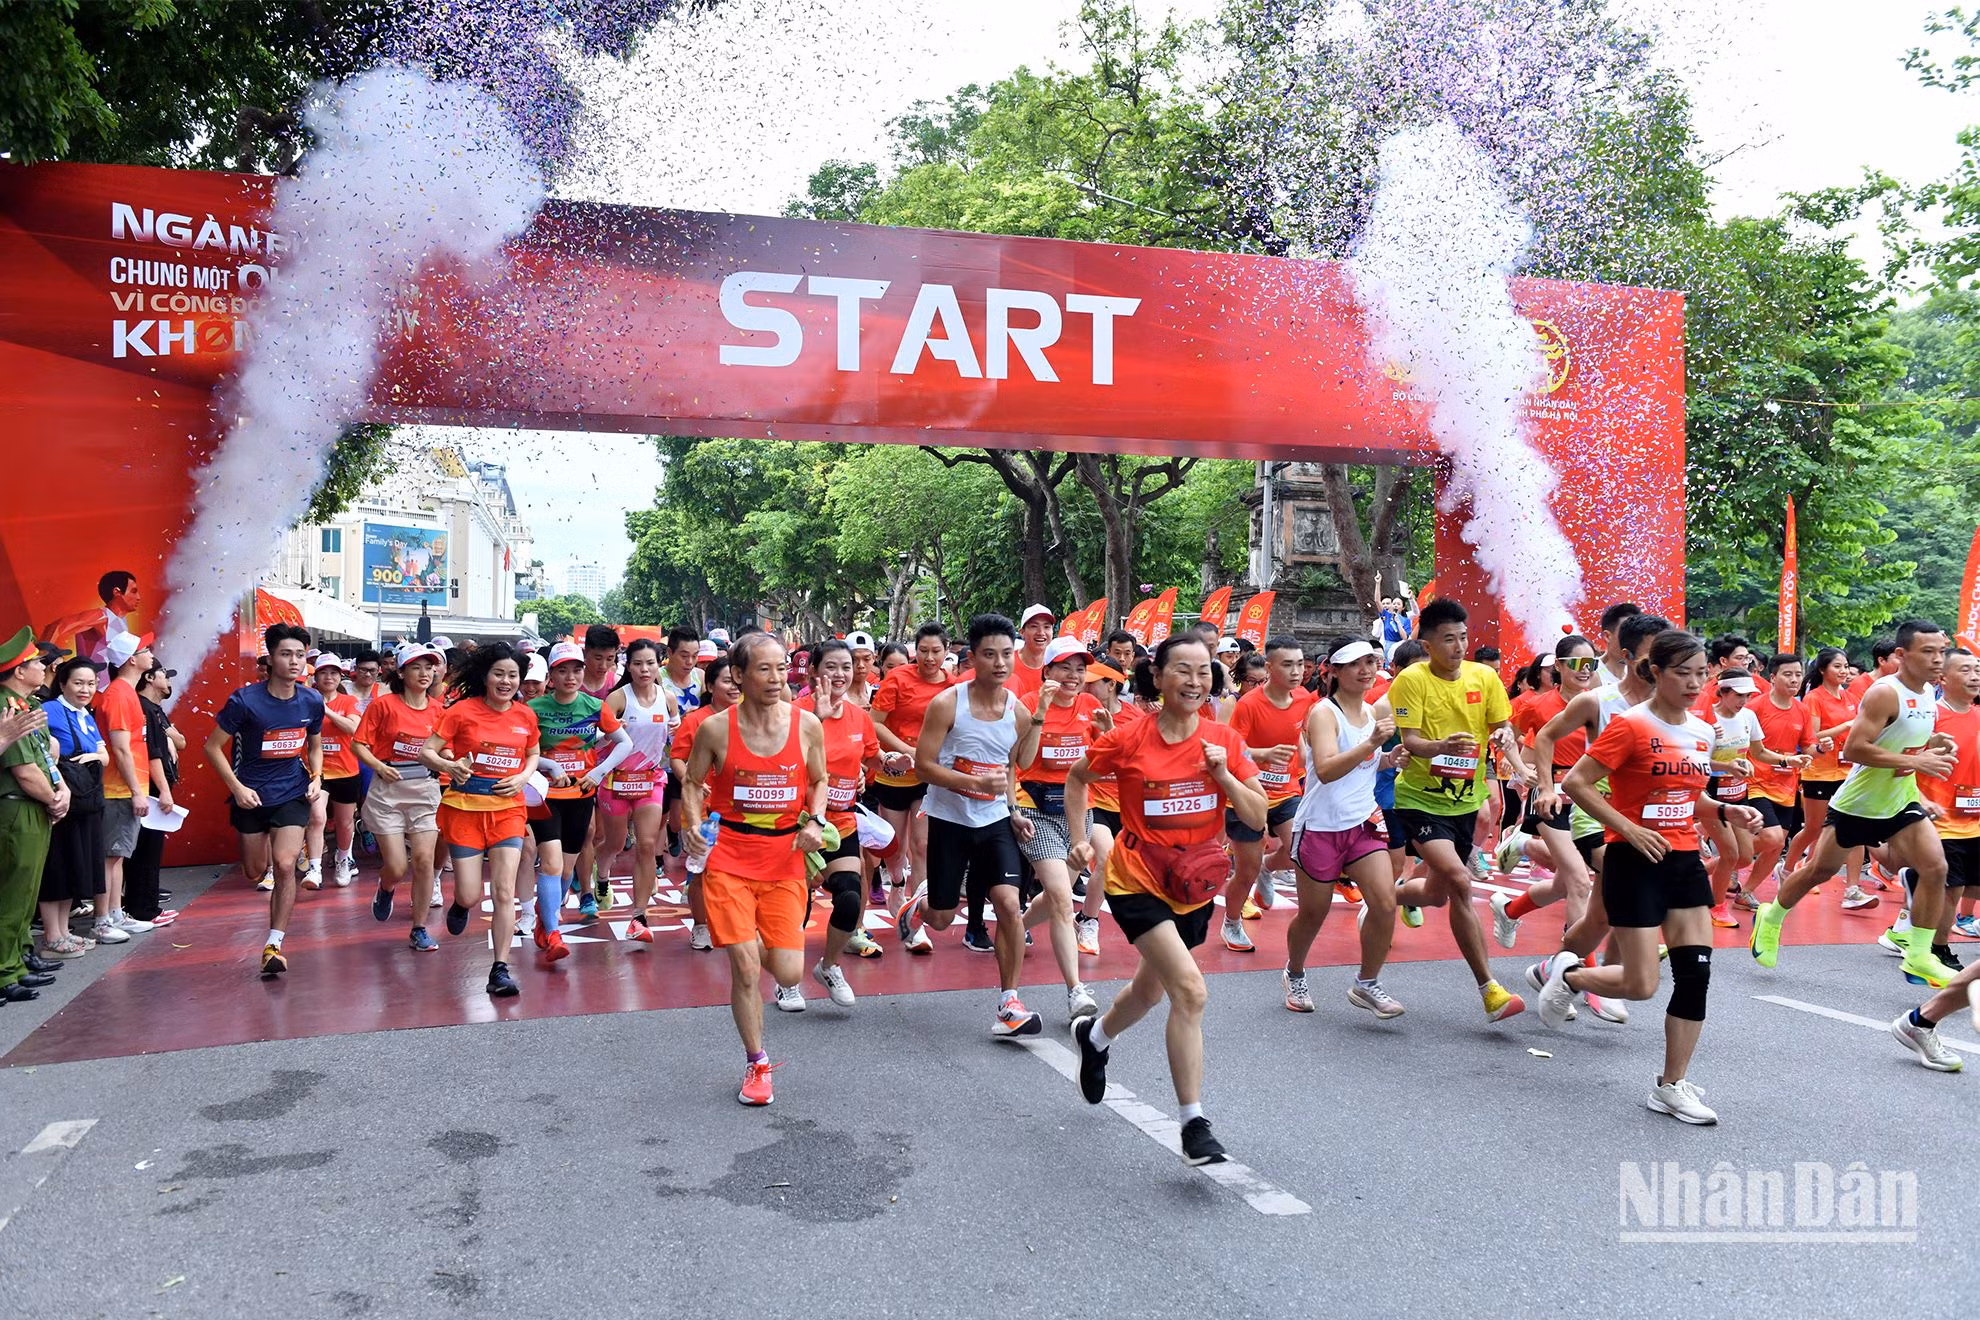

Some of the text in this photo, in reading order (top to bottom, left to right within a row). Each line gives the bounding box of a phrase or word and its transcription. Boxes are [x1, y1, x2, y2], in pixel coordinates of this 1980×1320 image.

[112, 202, 259, 256] NGÀN
[110, 257, 188, 288] CHUNG
[194, 266, 231, 294] MỘT
[110, 289, 144, 312] VÌ
[151, 291, 227, 316] CỘNG
[719, 271, 1143, 385] START
[365, 538, 408, 548] Family's Day
[372, 568, 403, 585] 900
[272, 741, 298, 749] 50632
[1053, 748, 1080, 757] 50739
[485, 756, 513, 767] 50249
[1443, 757, 1470, 767] 10485
[1261, 771, 1284, 782] 10268
[748, 789, 785, 799] 50099
[1162, 799, 1201, 813] 51226
